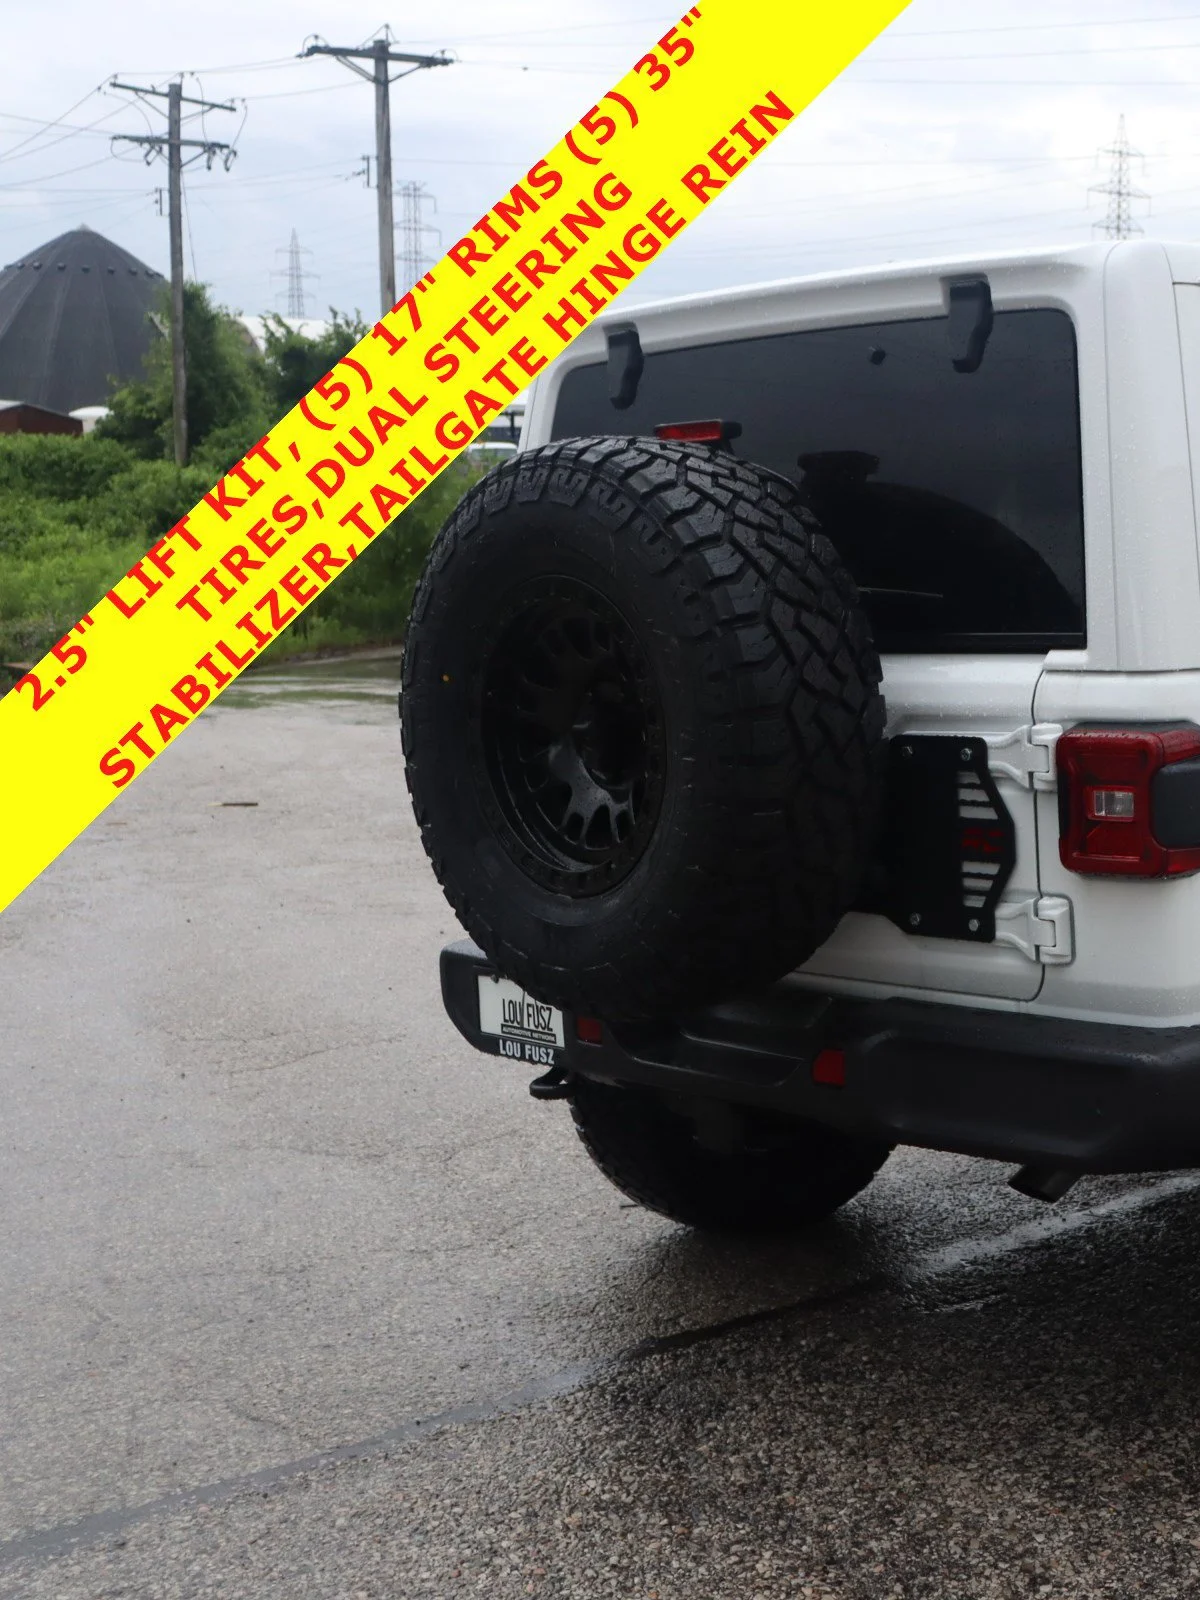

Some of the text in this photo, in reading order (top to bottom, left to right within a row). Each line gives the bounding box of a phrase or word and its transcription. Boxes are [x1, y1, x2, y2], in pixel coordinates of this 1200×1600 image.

[502, 998, 554, 1032] LOU FUSZ
[499, 1039, 555, 1064] LOU FUSZ
